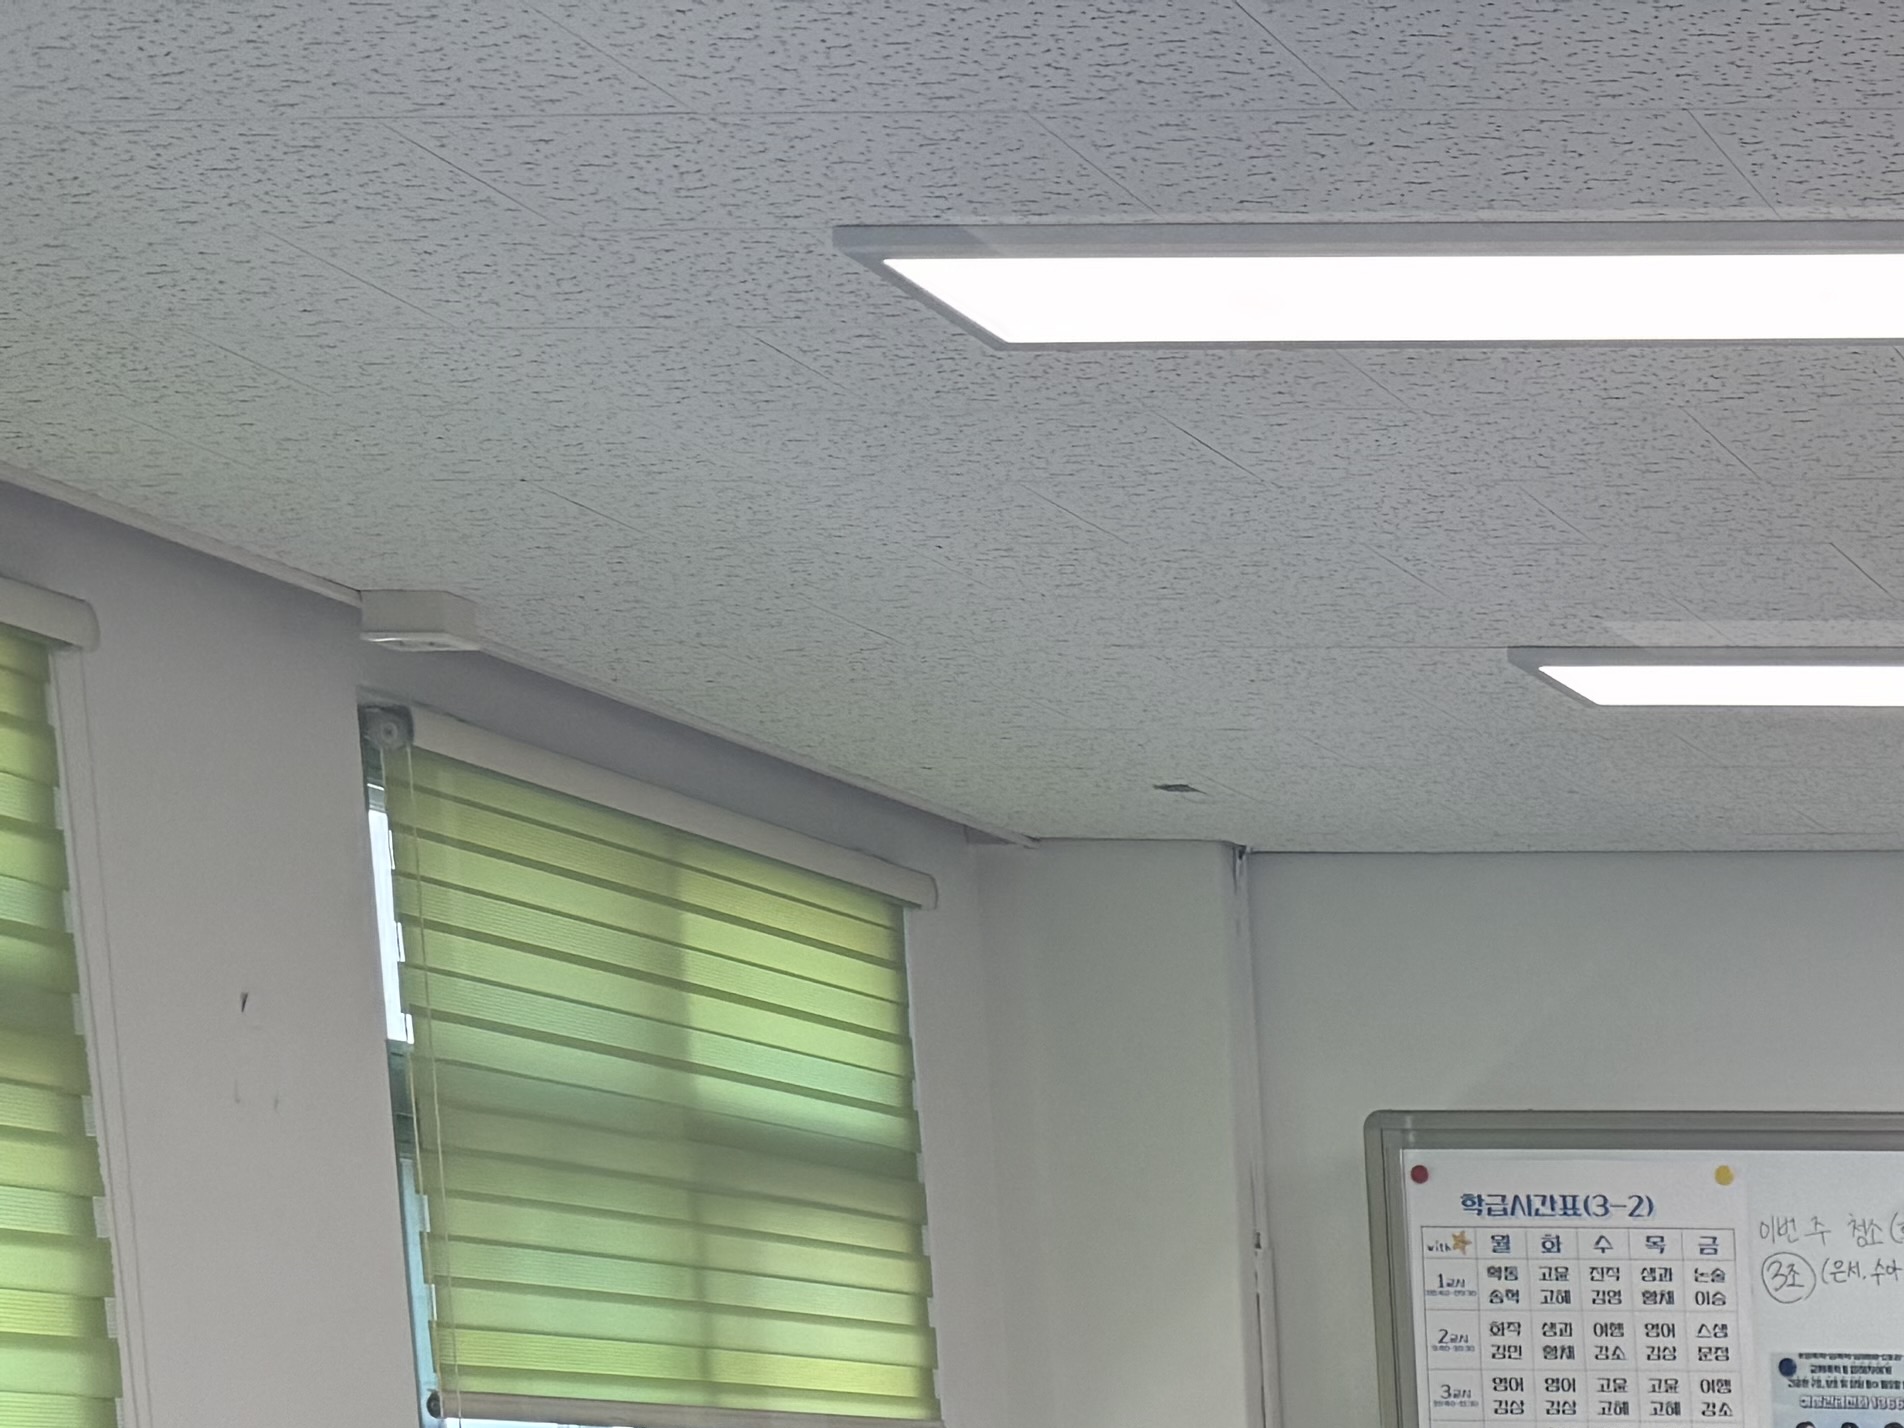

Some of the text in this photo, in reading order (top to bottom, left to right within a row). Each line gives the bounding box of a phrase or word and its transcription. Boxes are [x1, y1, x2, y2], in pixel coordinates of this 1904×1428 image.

[1760, 1216, 1799, 1244] 이번
[1804, 1216, 1831, 1246] 주
[1490, 1234, 1511, 1254] 월
[1541, 1233, 1562, 1254] 화
[1594, 1235, 1614, 1254] 수
[1645, 1235, 1666, 1254] 목
[1698, 1236, 1719, 1255] 금
[1766, 1260, 1805, 1292] 3조
[1643, 1322, 1676, 1339] 영어
[1491, 1376, 1524, 1393] 영어
[1544, 1377, 1576, 1393] 영어
